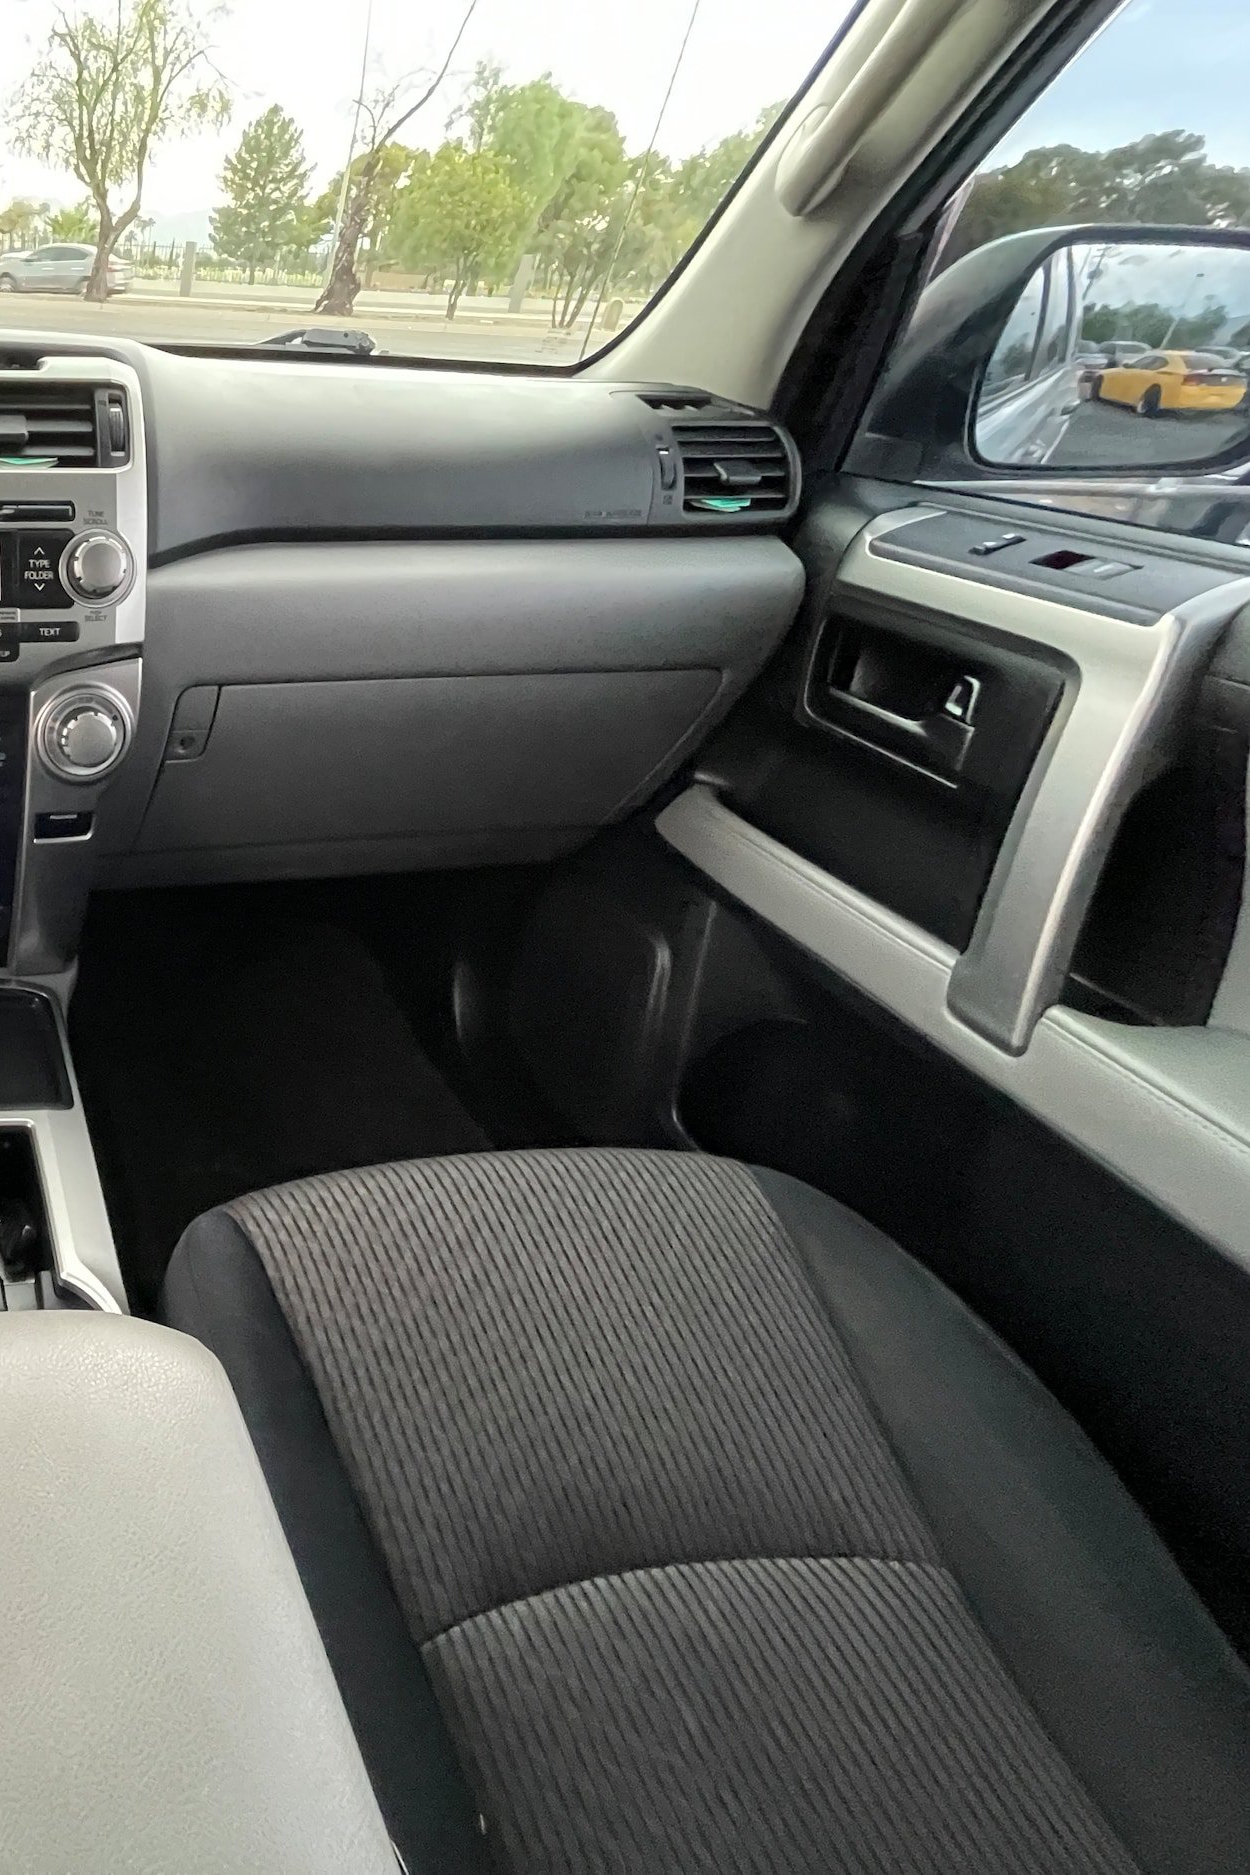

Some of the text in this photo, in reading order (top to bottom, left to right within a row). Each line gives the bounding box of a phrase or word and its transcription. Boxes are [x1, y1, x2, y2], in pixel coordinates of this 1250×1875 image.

[29, 559, 51, 568] TYPE
[24, 571, 54, 580] FOLDER
[39, 627, 61, 636] TEXT
